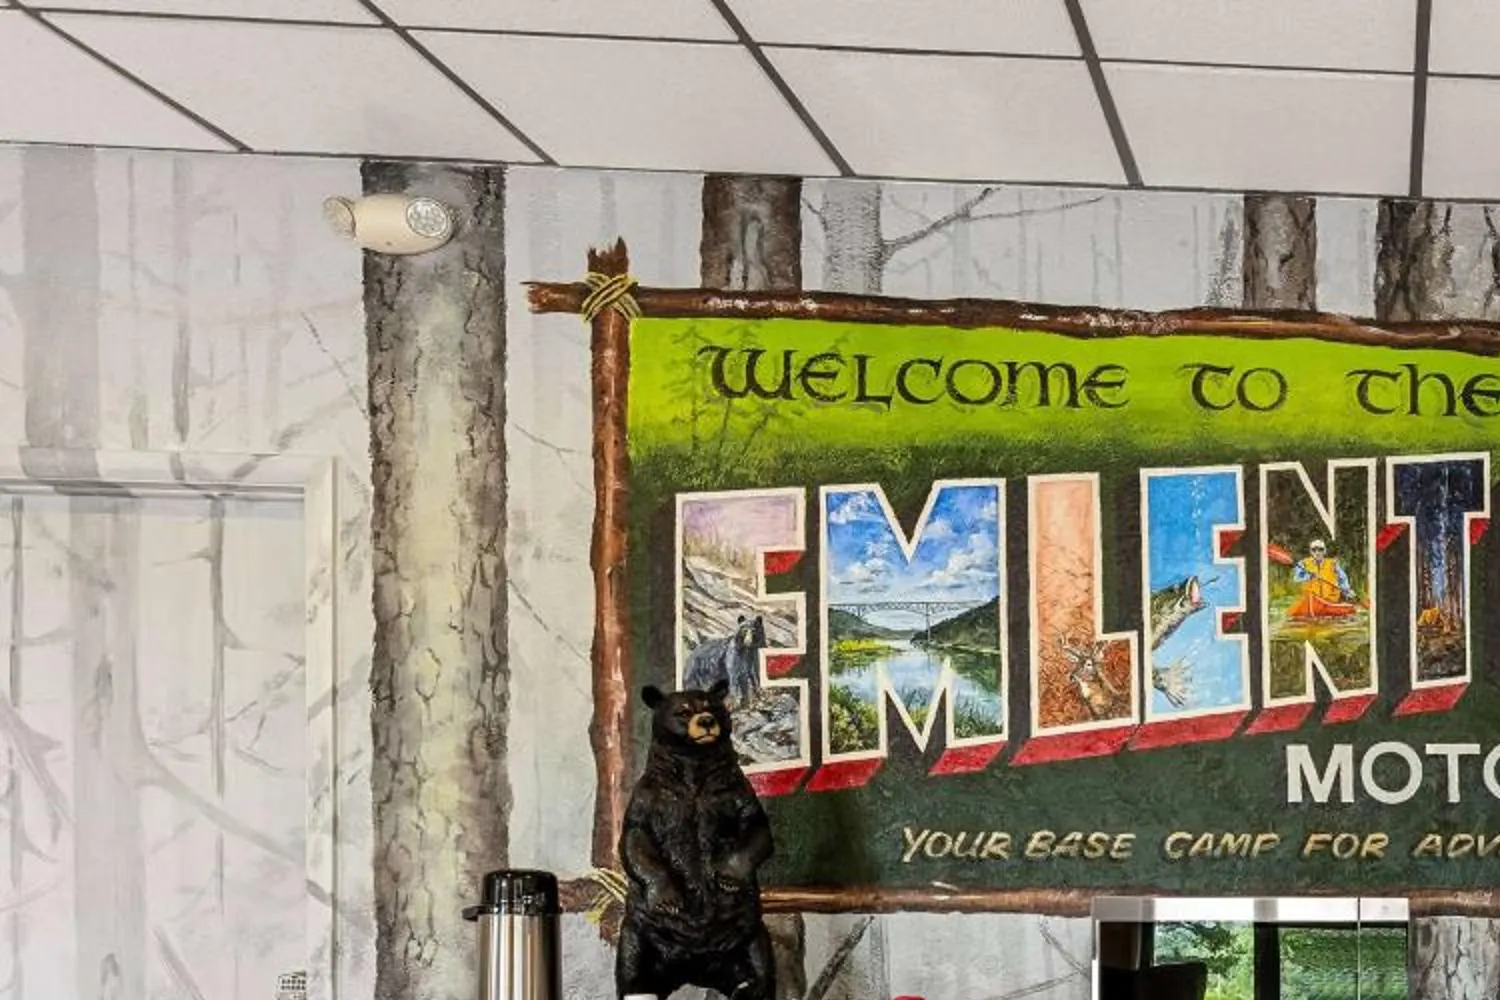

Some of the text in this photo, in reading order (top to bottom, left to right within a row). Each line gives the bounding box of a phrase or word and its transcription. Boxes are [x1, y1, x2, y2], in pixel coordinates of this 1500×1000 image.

[698, 346, 1131, 410] WELCOME
[1182, 363, 1288, 412] TO
[901, 826, 1013, 864] YOUR
[1023, 828, 1137, 860] BASE
[1163, 831, 1281, 861] CAMP
[1302, 831, 1390, 861] FOR
